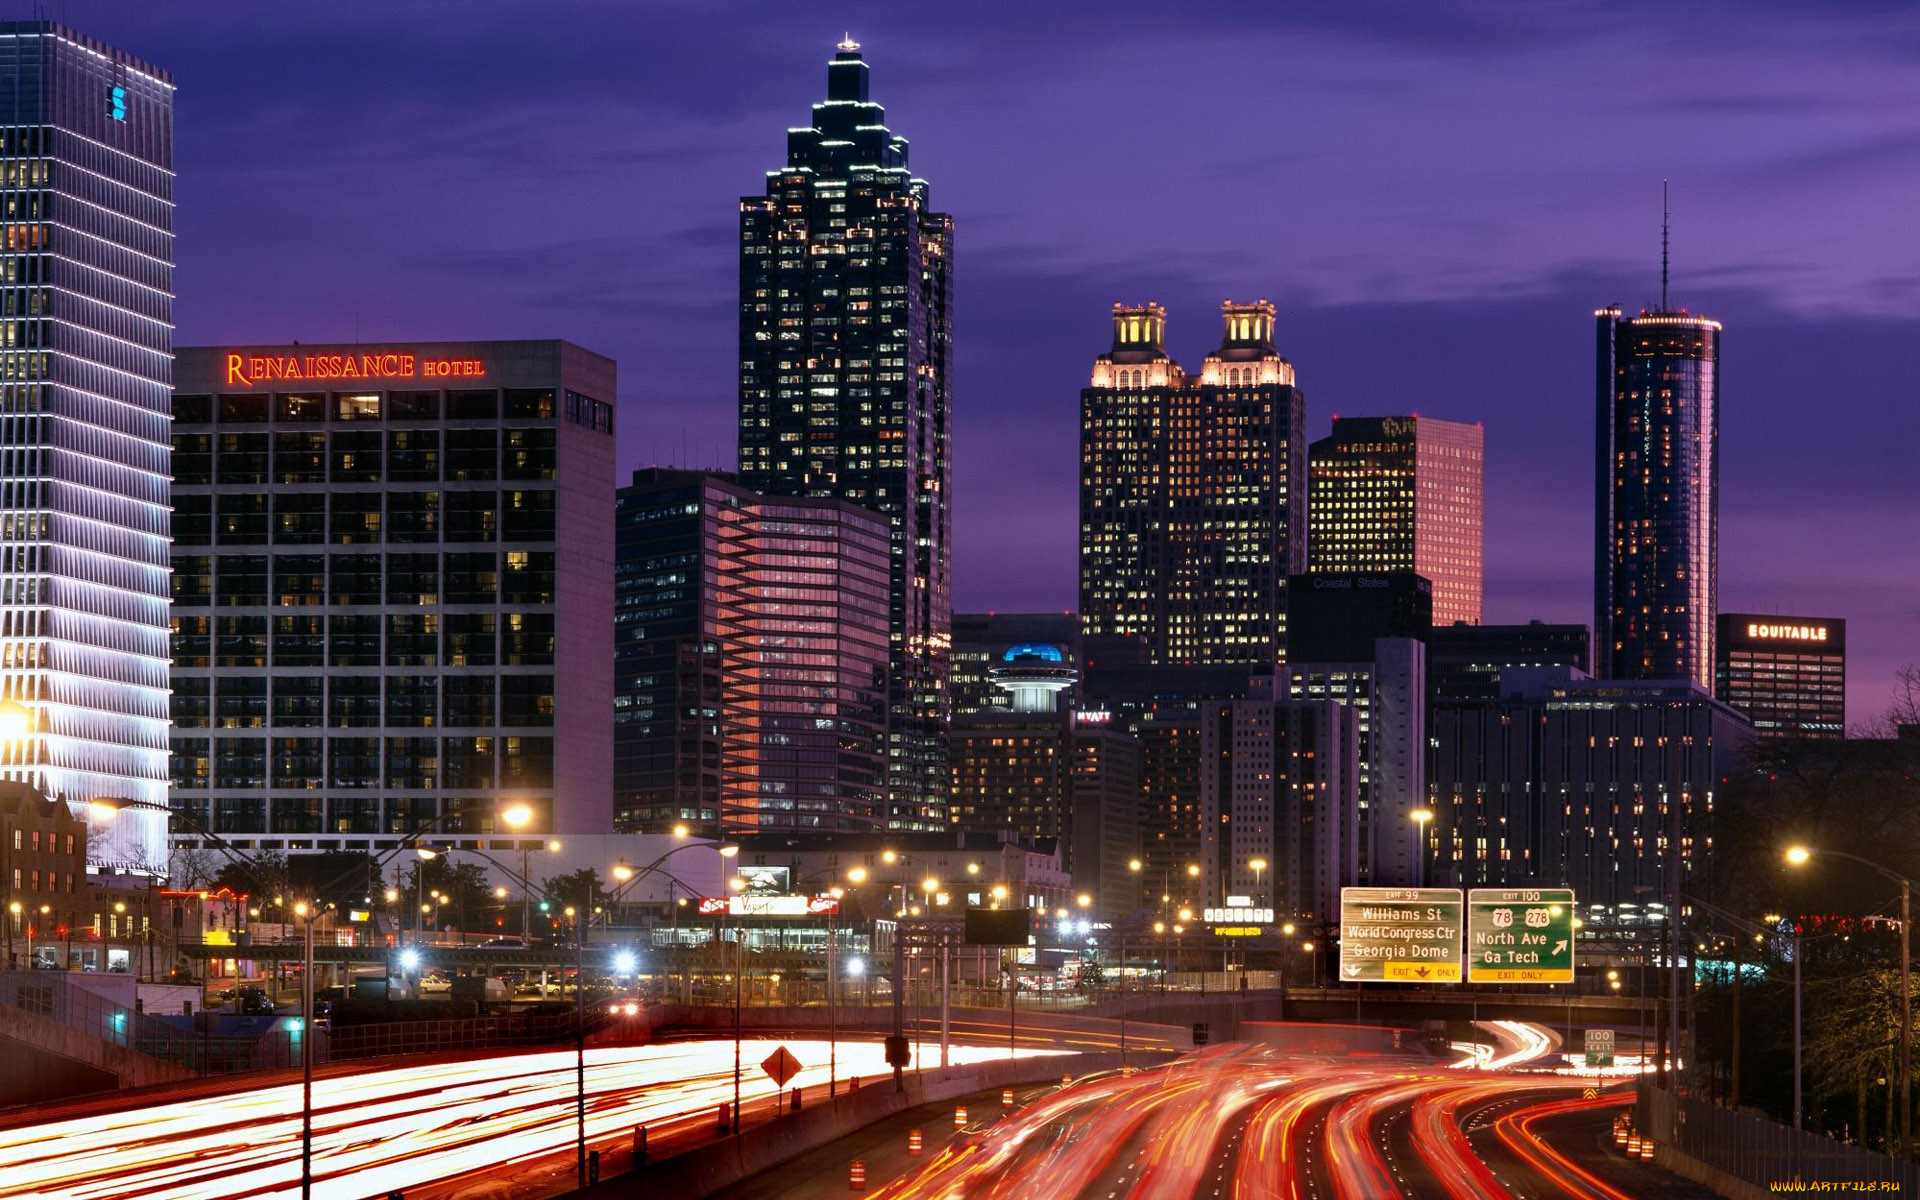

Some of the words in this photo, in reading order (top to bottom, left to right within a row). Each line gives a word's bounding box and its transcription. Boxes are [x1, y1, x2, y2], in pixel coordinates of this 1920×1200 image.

[228, 355, 414, 385] RENAISSANCE
[424, 361, 485, 376] HOTEL
[1313, 578, 1351, 588] Coastal
[1358, 578, 1389, 588] States
[1748, 624, 1827, 640] EQUITABLE
[1077, 711, 1110, 721] HYATT
[1385, 891, 1401, 899] EXIT
[1405, 891, 1419, 900] 99
[1502, 892, 1518, 900] EXIT
[1522, 891, 1540, 901] 100
[1205, 910, 1272, 921] VARTY
[1362, 907, 1420, 920] Williams
[1427, 908, 1442, 920] St
[1495, 912, 1511, 923] 78
[1527, 912, 1547, 923] 278
[1348, 926, 1380, 938] World
[1382, 926, 1435, 942] Congress
[1436, 927, 1455, 939] Ctr
[1476, 932, 1515, 945] North
[1521, 932, 1547, 945] Ave
[1354, 944, 1406, 960] Georgia
[1412, 945, 1449, 957] Dome
[1484, 951, 1501, 963] Ga
[1507, 951, 1539, 963] Tech
[1393, 968, 1409, 976] EXIT
[1437, 968, 1456, 977] ONLY
[1497, 971, 1516, 979] EXIT
[1521, 971, 1544, 979] ONLY
[1590, 1031, 1610, 1041] 100
